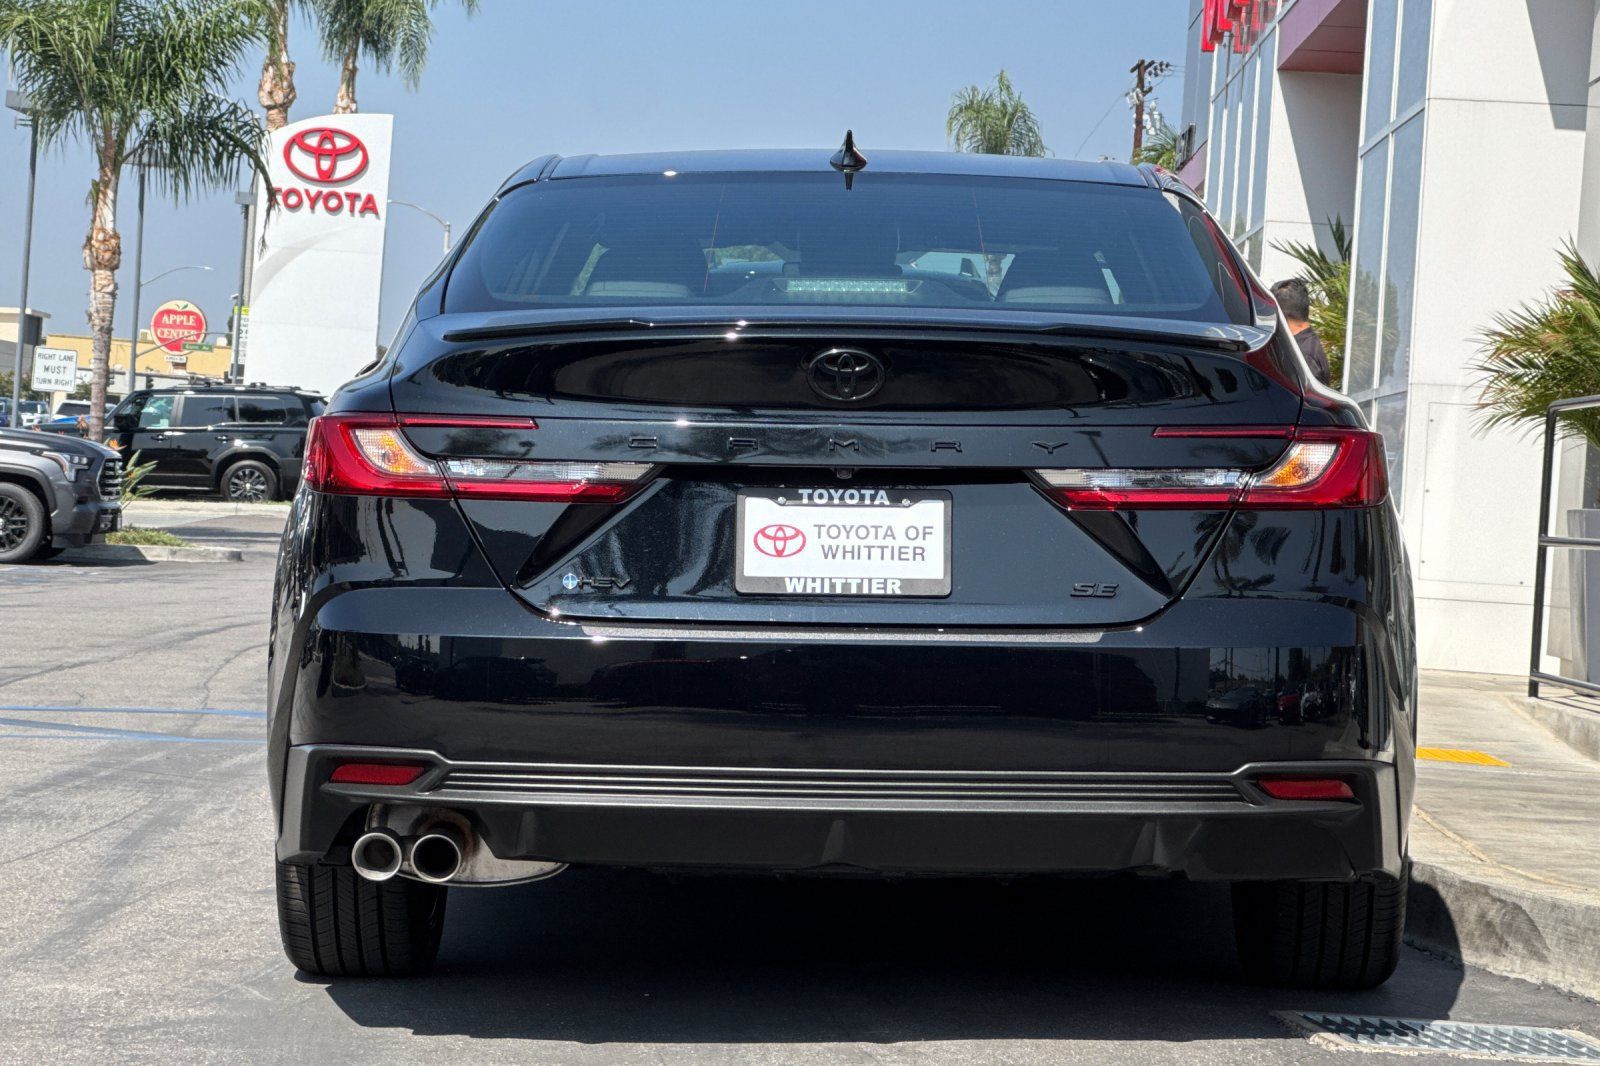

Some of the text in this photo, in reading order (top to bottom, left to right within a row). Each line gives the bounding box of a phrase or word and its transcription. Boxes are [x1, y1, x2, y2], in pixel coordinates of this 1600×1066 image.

[162, 314, 197, 326] APPLE
[157, 328, 197, 341] CENTER
[44, 365, 67, 374] MUST
[35, 377, 73, 387] TURN RIGHT
[627, 436, 1069, 455] CAMRY
[798, 489, 890, 505] TOYOTA
[813, 524, 934, 541] TOYOTA OF
[821, 544, 926, 562] WHITTIER
[578, 576, 632, 589] HEV
[784, 577, 902, 595] WHITTIER
[1070, 583, 1119, 598] SE
